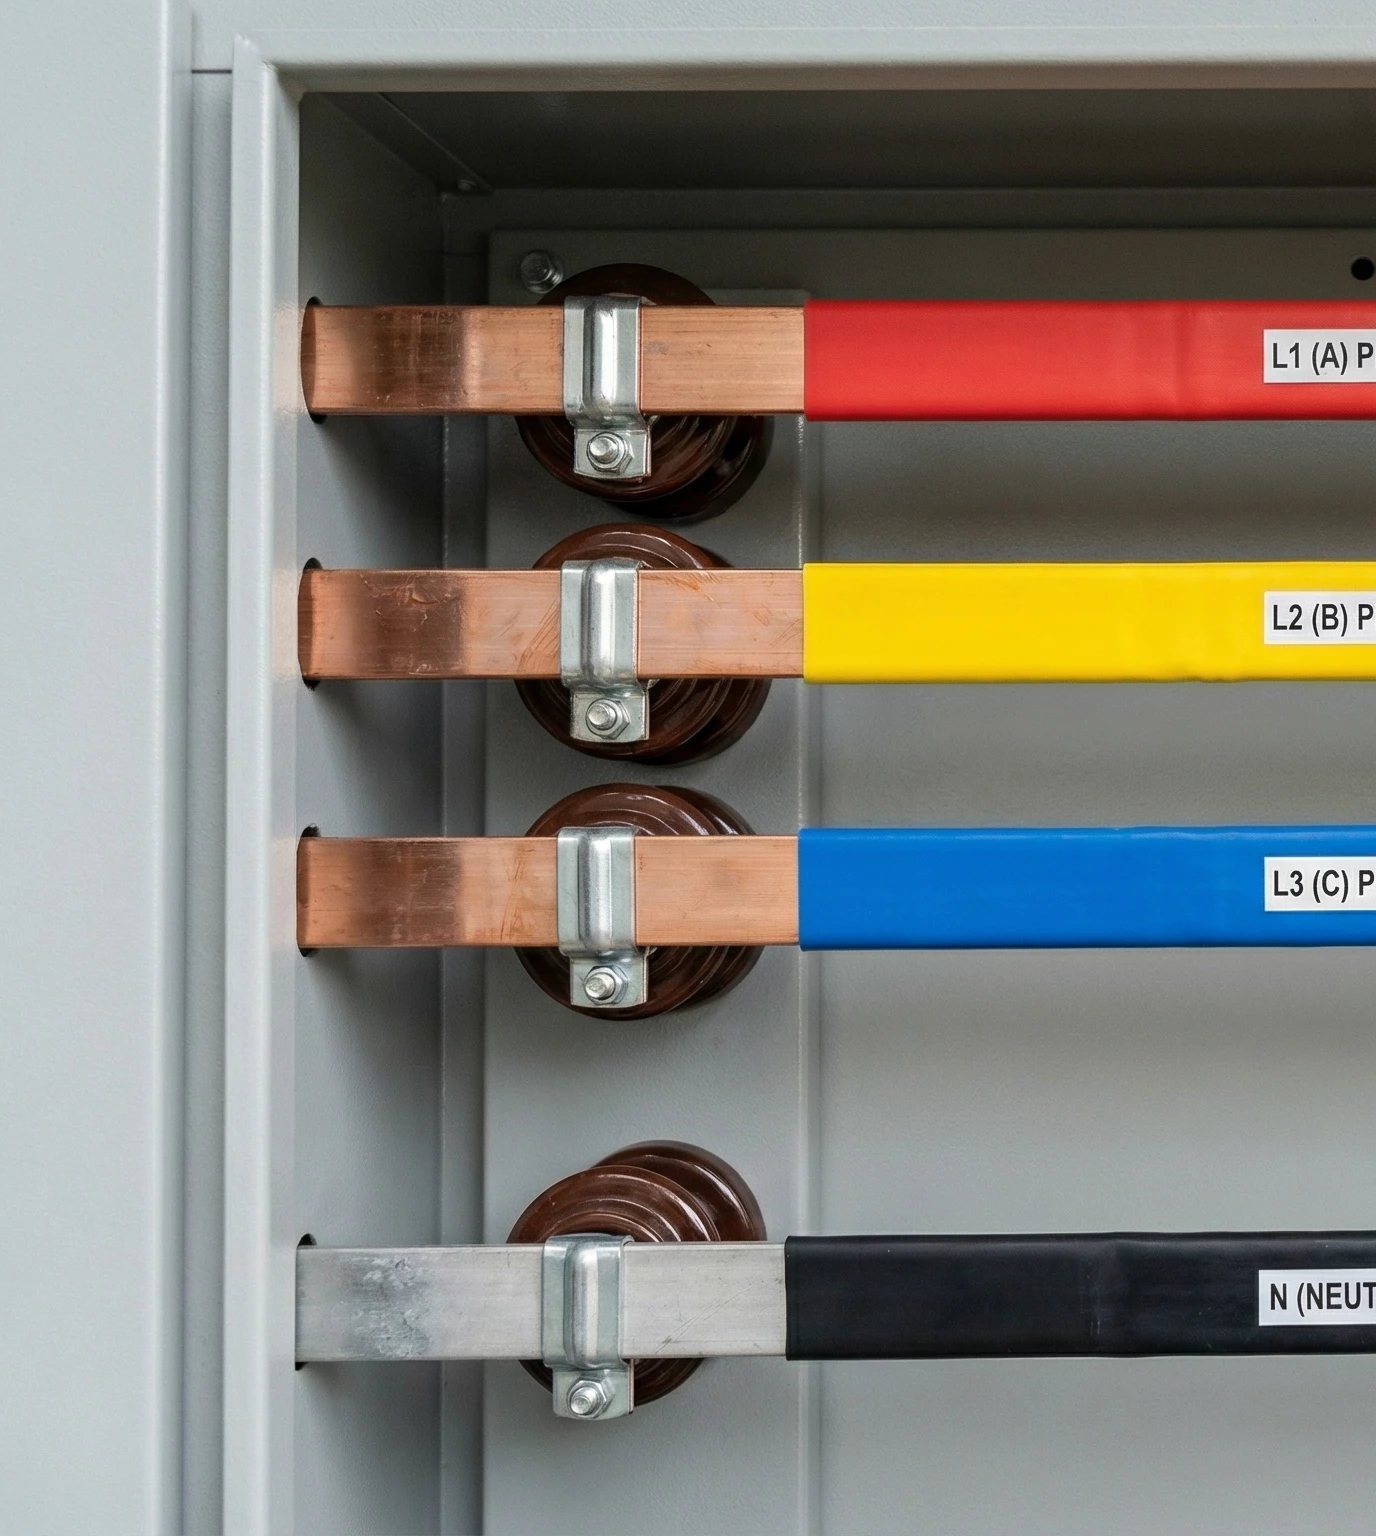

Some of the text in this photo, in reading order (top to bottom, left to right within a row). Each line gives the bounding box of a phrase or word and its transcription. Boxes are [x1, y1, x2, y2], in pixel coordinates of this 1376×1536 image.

[1272, 342, 1300, 370] L1
[1311, 341, 1348, 376] (A)
[1273, 603, 1303, 631] L2
[1312, 603, 1348, 638] (B)
[1273, 870, 1304, 898] L3
[1312, 869, 1349, 904] (C)
[1270, 1283, 1288, 1311] N
